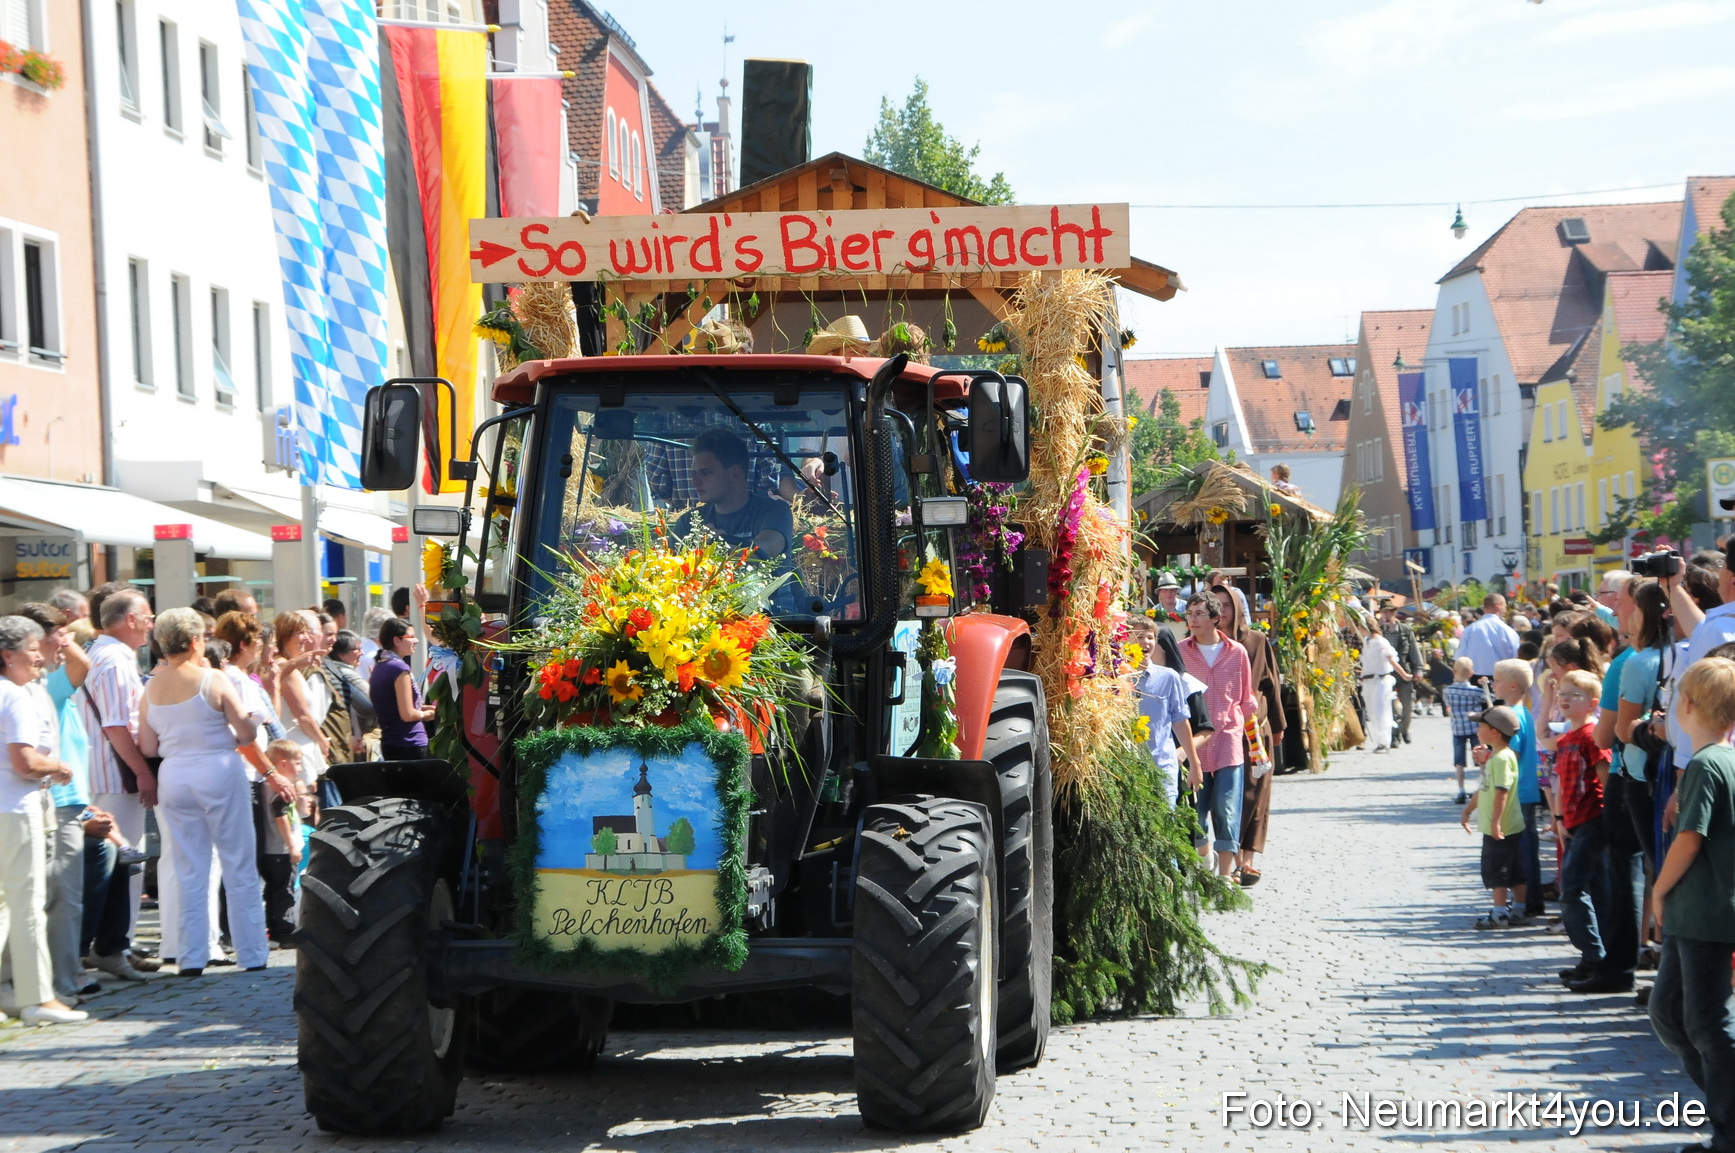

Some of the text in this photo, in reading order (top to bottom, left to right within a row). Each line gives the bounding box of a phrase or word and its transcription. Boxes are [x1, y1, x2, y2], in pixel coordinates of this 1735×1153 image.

[518, 205, 1115, 278] So wird's Bier g'macht
[1465, 418, 1479, 475] RUPPERT
[586, 878, 675, 912] KLJB
[547, 907, 710, 941] Pelchenhofen
